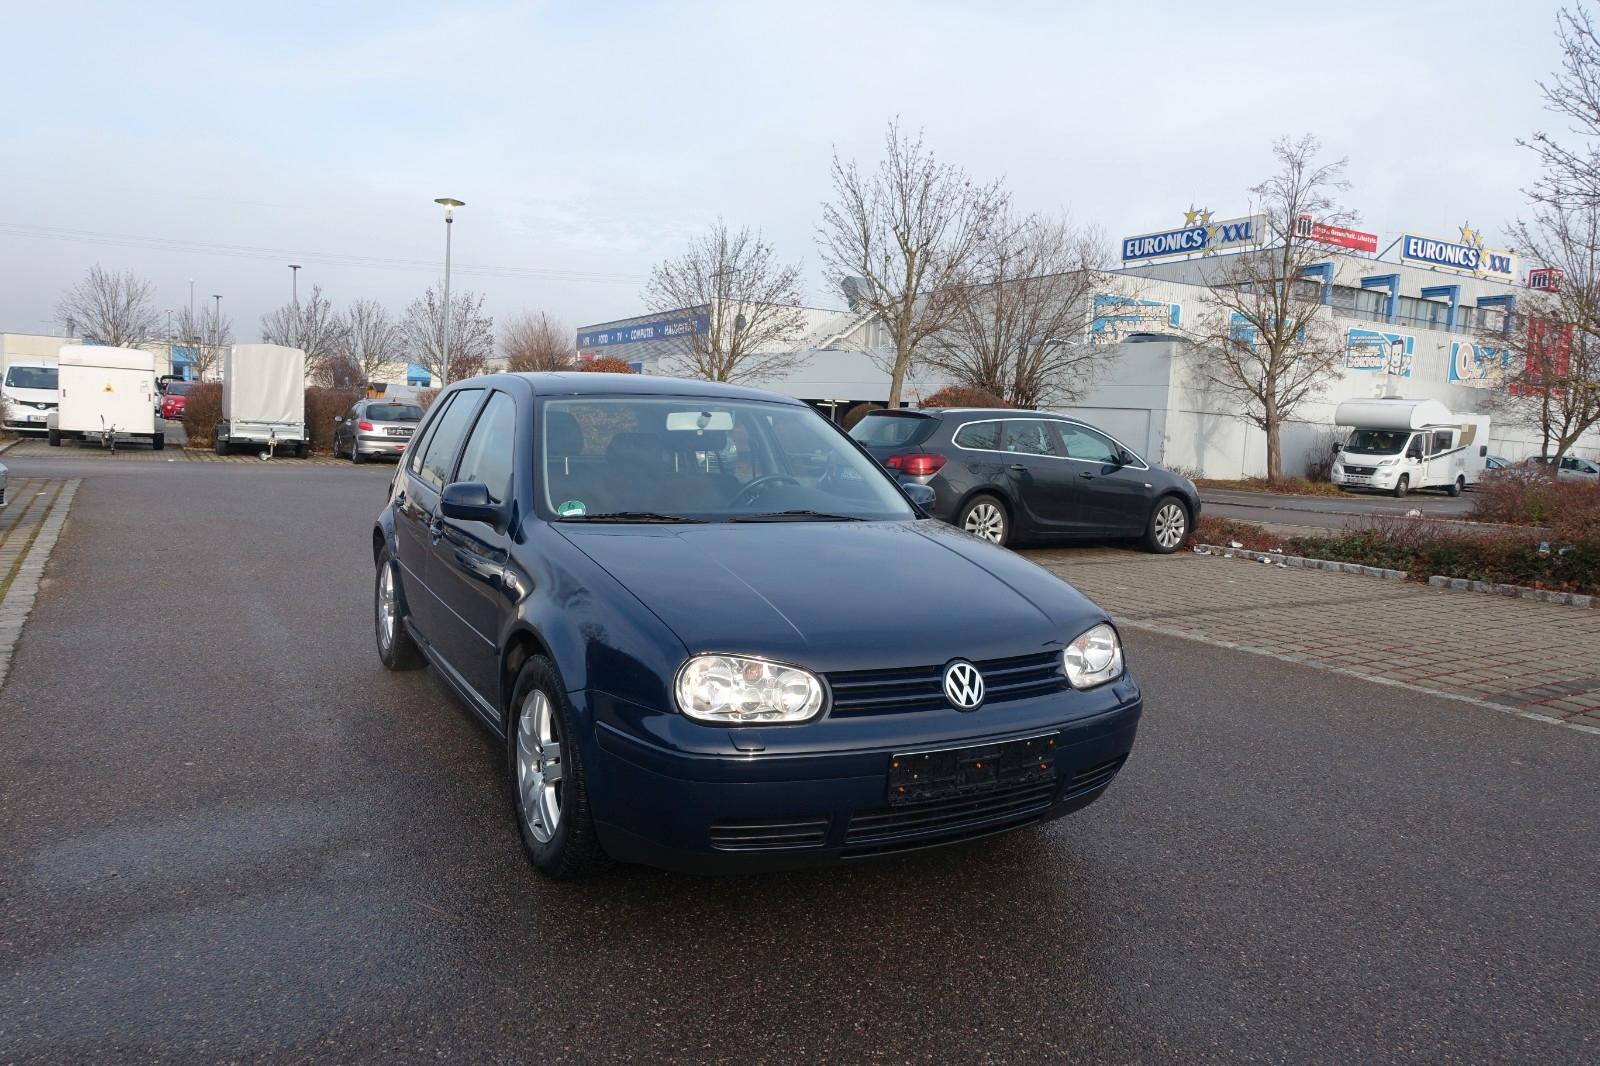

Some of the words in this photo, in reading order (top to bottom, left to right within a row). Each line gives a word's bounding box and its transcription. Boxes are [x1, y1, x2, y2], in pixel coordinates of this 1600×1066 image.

[1126, 229, 1203, 257] EURONICS
[1221, 221, 1255, 244] XXL
[1408, 238, 1477, 267] EURONICS
[1488, 254, 1512, 274] XXL
[630, 327, 654, 340] COMPUTER
[946, 663, 984, 708] VW
